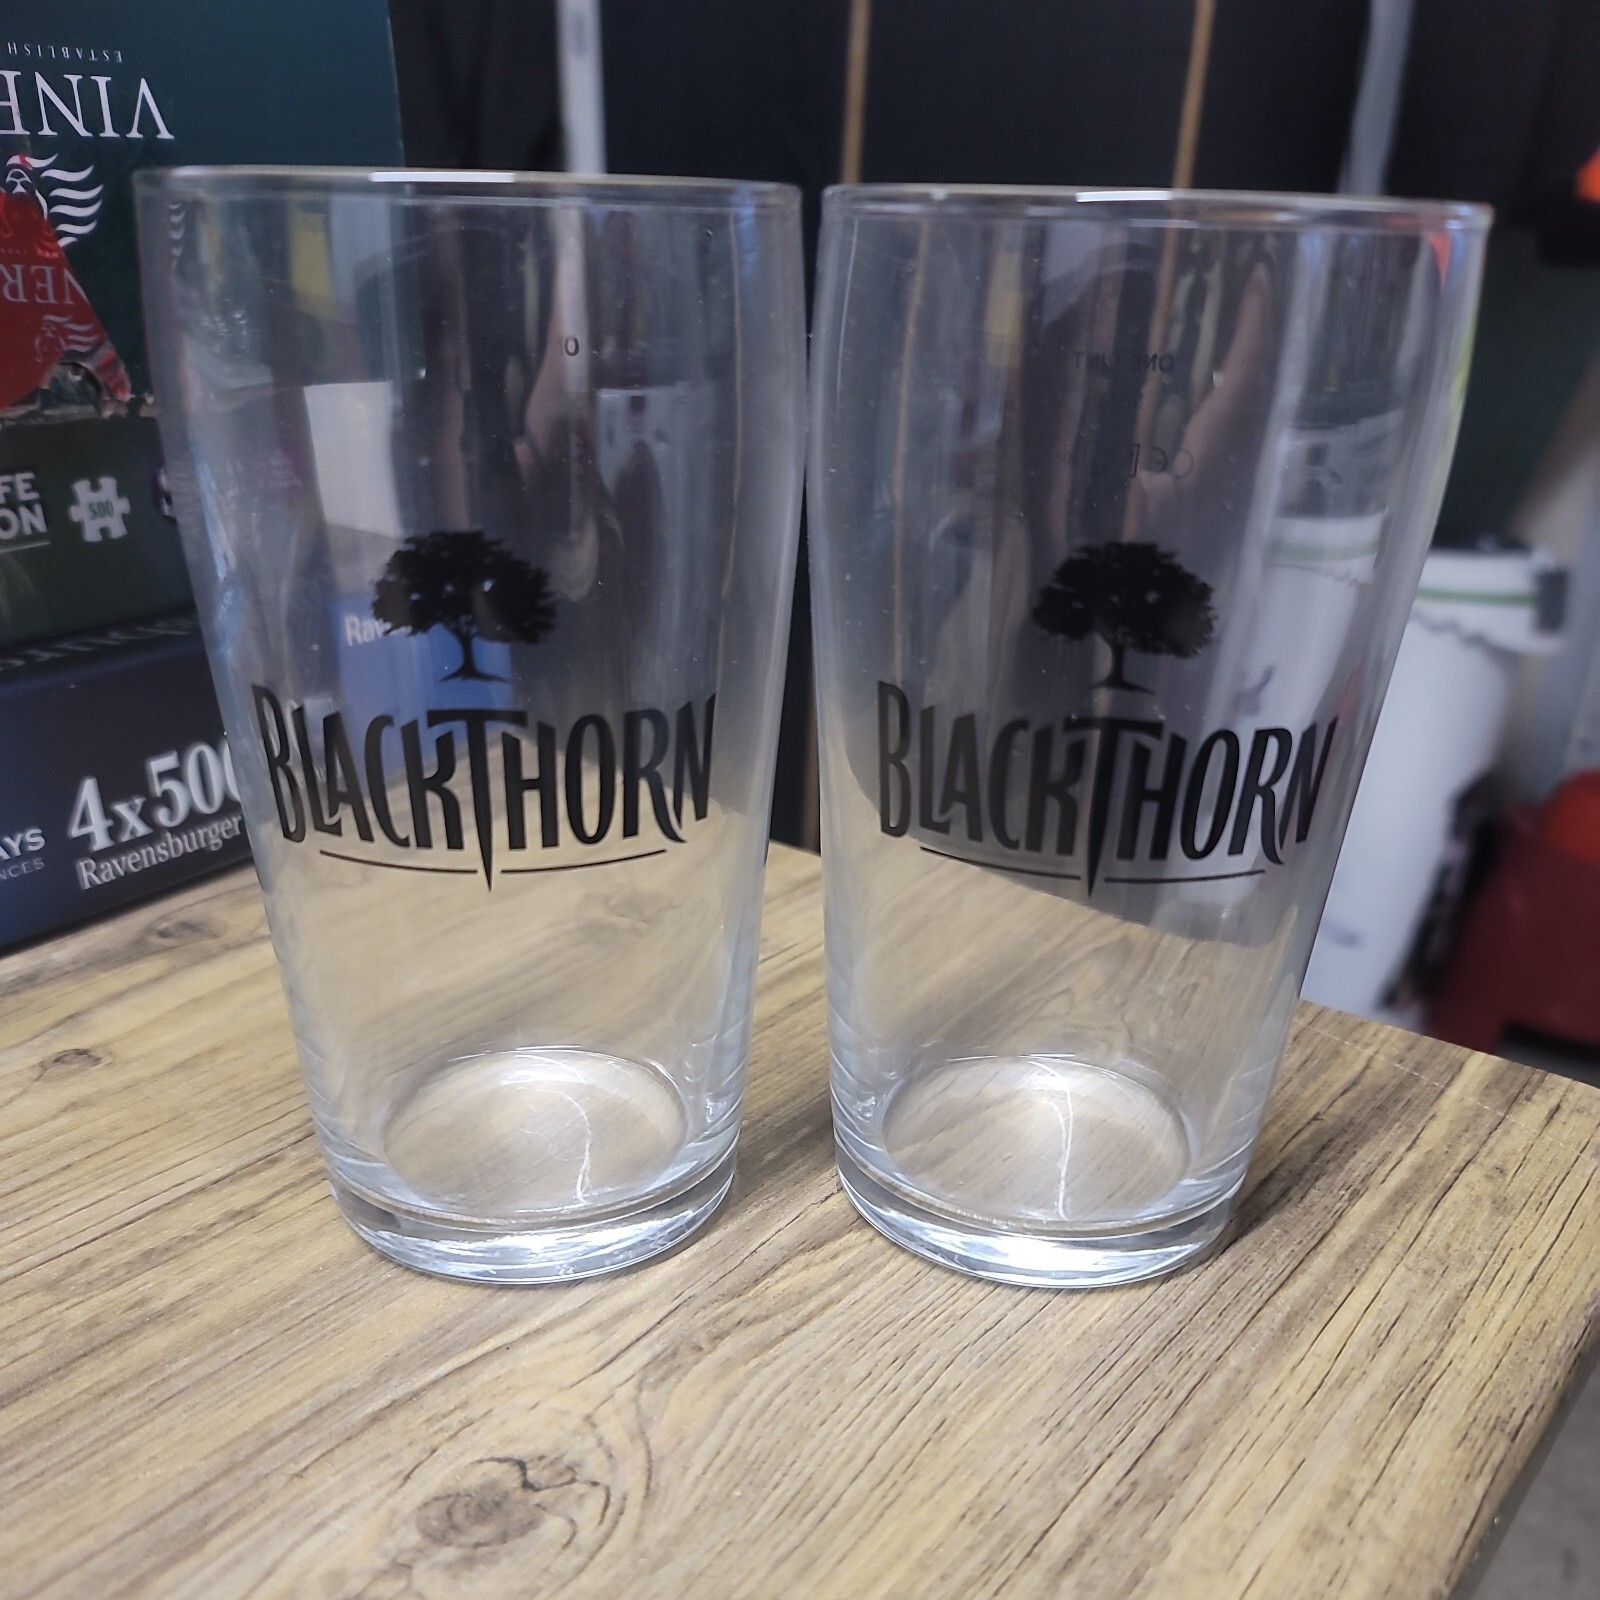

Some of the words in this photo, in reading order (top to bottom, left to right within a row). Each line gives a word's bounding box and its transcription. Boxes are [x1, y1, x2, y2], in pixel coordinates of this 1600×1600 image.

[88, 501, 115, 520] 500
[77, 814, 243, 890] Ravensburger
[252, 684, 717, 891] BLACKTHORN
[877, 680, 1339, 898] BLACKTHORN
